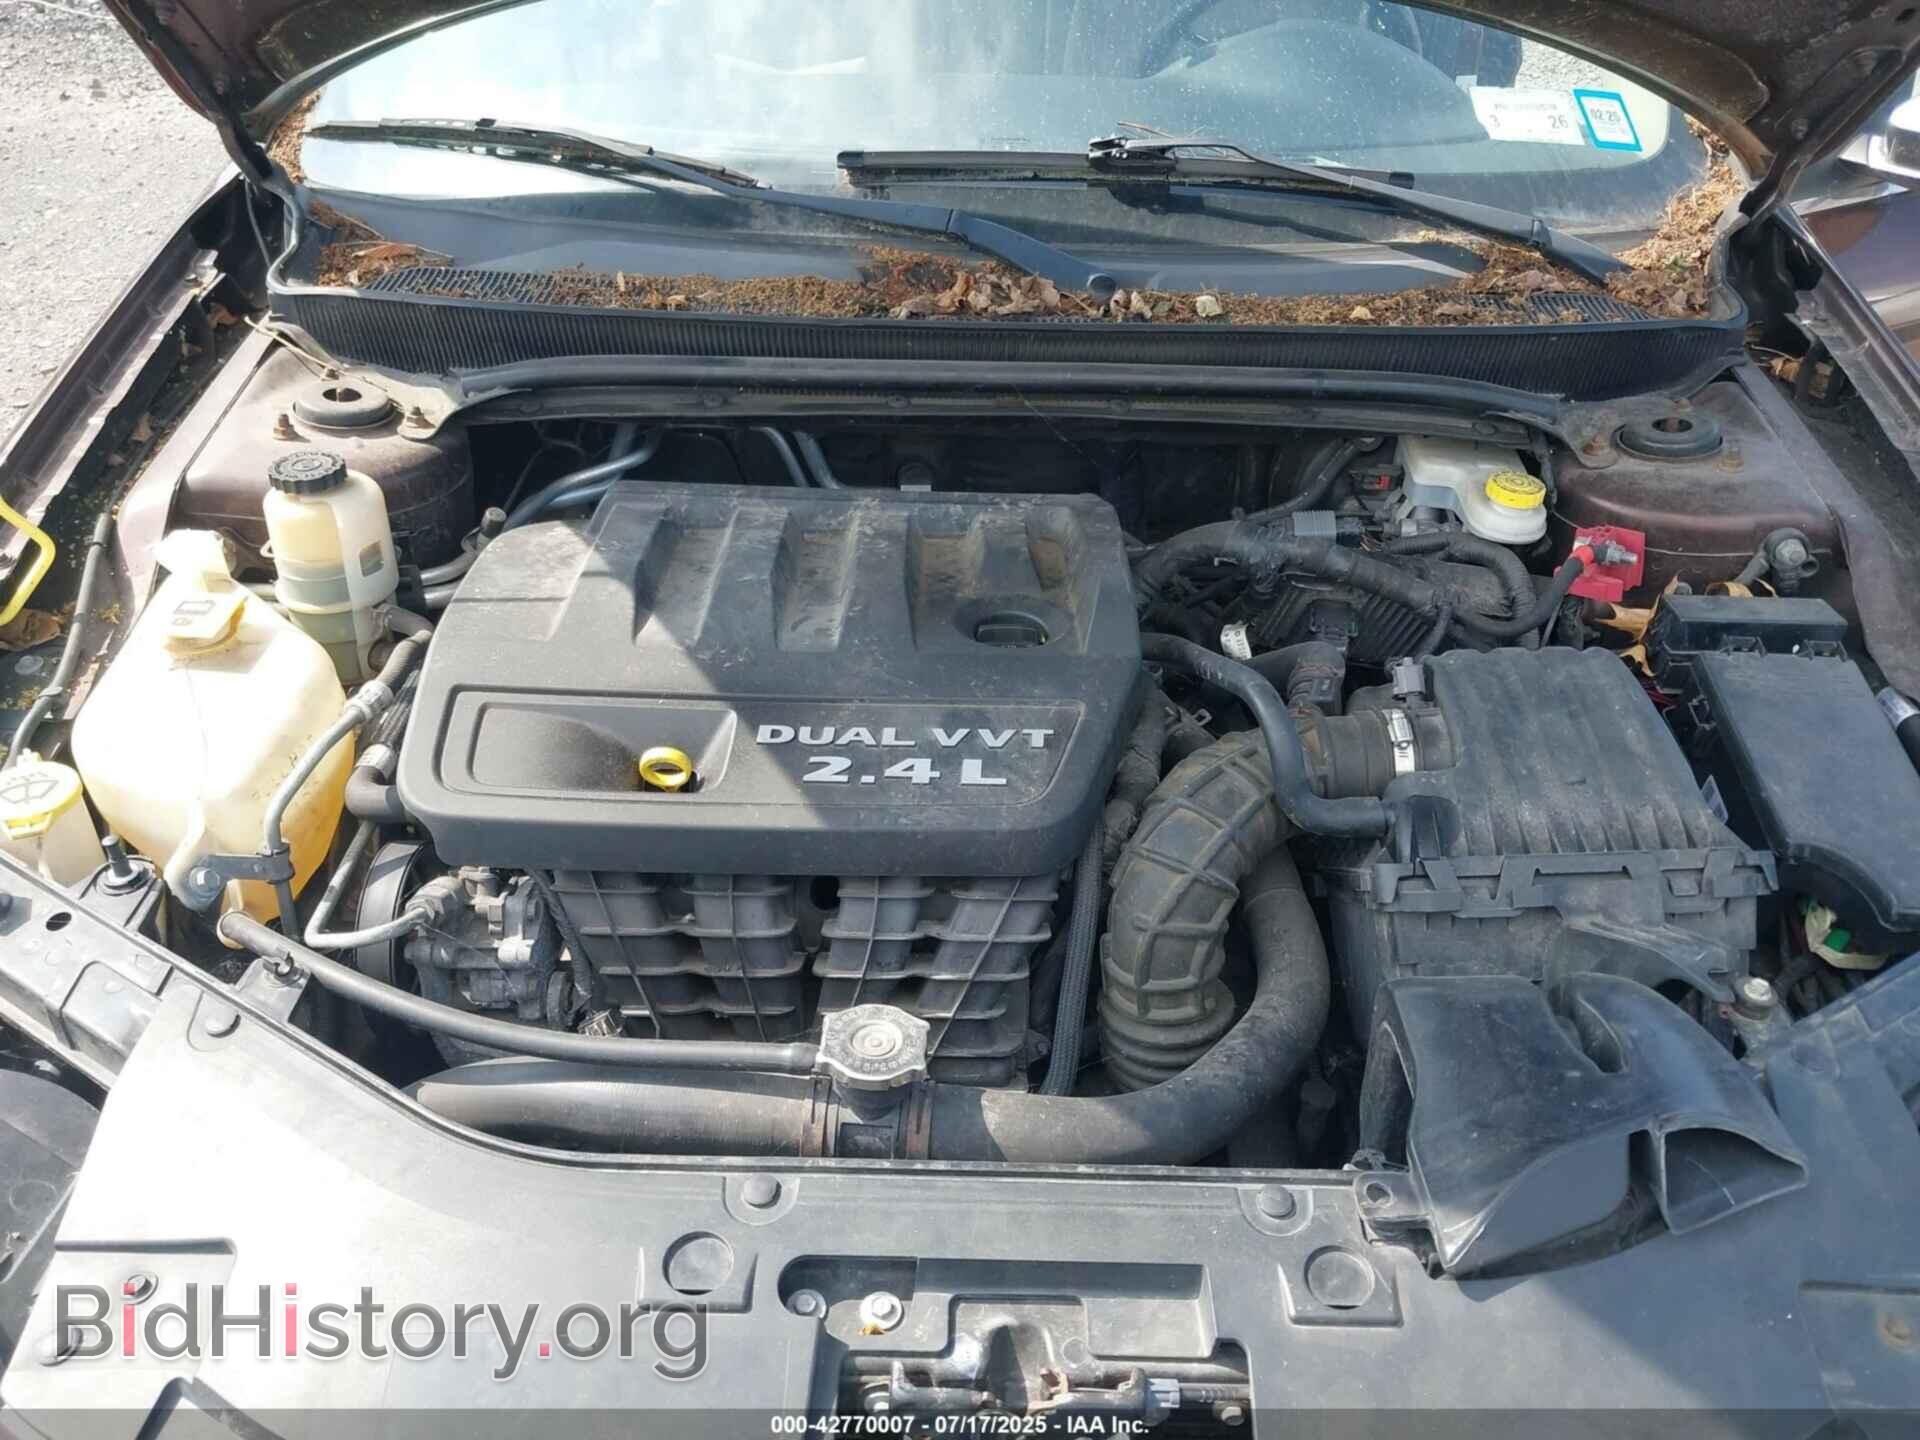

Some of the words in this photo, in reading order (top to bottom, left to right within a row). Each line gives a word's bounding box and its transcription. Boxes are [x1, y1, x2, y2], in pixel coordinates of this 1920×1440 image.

[756, 724, 916, 747] DUAL
[931, 727, 1055, 748] VVT
[802, 756, 941, 785] 2.4
[960, 758, 1008, 786] L
